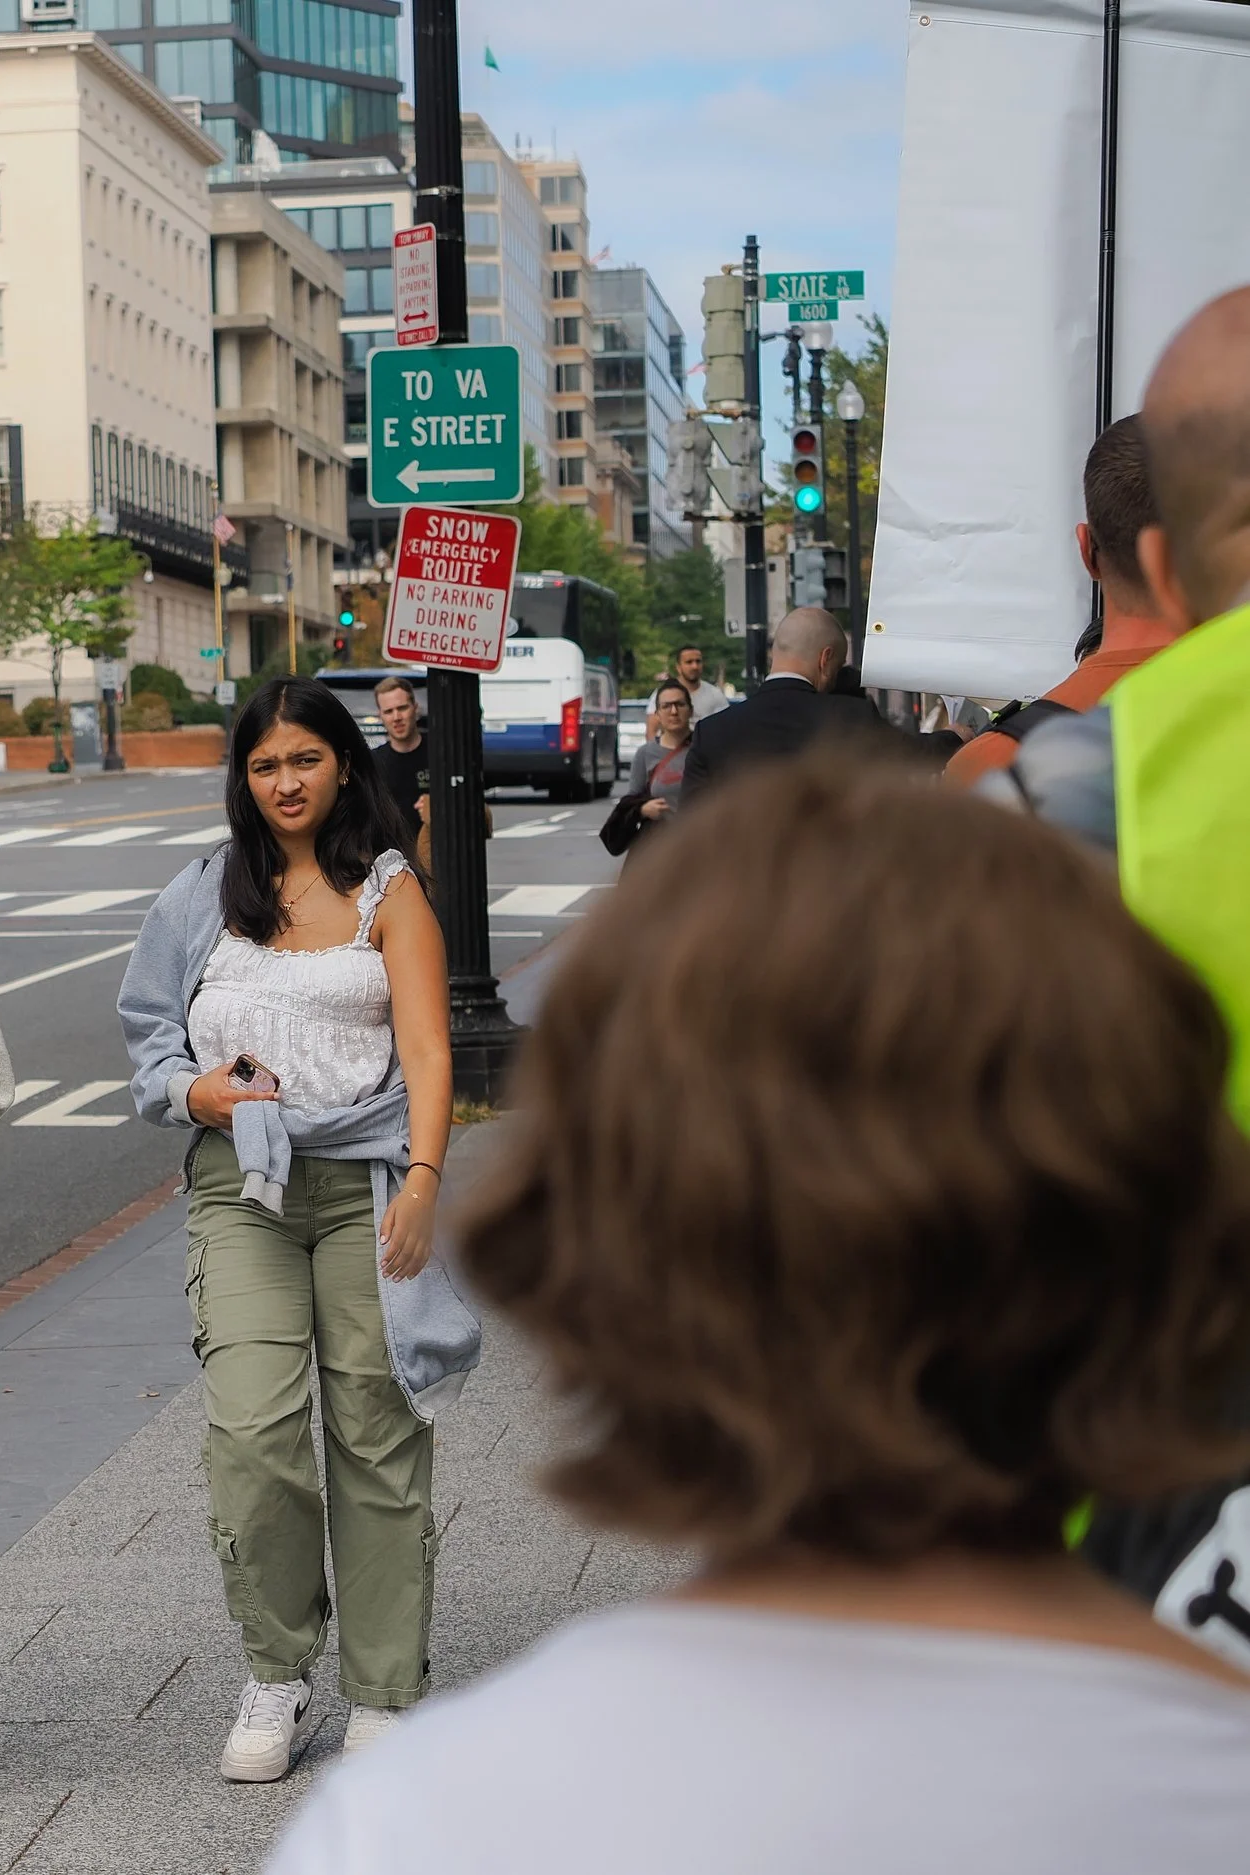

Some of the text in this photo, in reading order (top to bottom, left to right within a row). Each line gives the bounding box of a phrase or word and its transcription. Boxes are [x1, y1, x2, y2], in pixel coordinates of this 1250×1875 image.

[409, 249, 420, 262] NO
[778, 275, 830, 299] STATE
[800, 304, 827, 320] 1600
[401, 369, 487, 400] TO VA
[384, 414, 506, 447] E STREET
[426, 515, 489, 543] SNOW
[411, 538, 500, 563] EMERGENCY
[422, 558, 483, 585] ROUTE
[406, 583, 495, 611] NO PARKING
[416, 608, 477, 631] DURING
[398, 629, 492, 657] EMERGENCY
[422, 654, 463, 665] TOW AWAY
